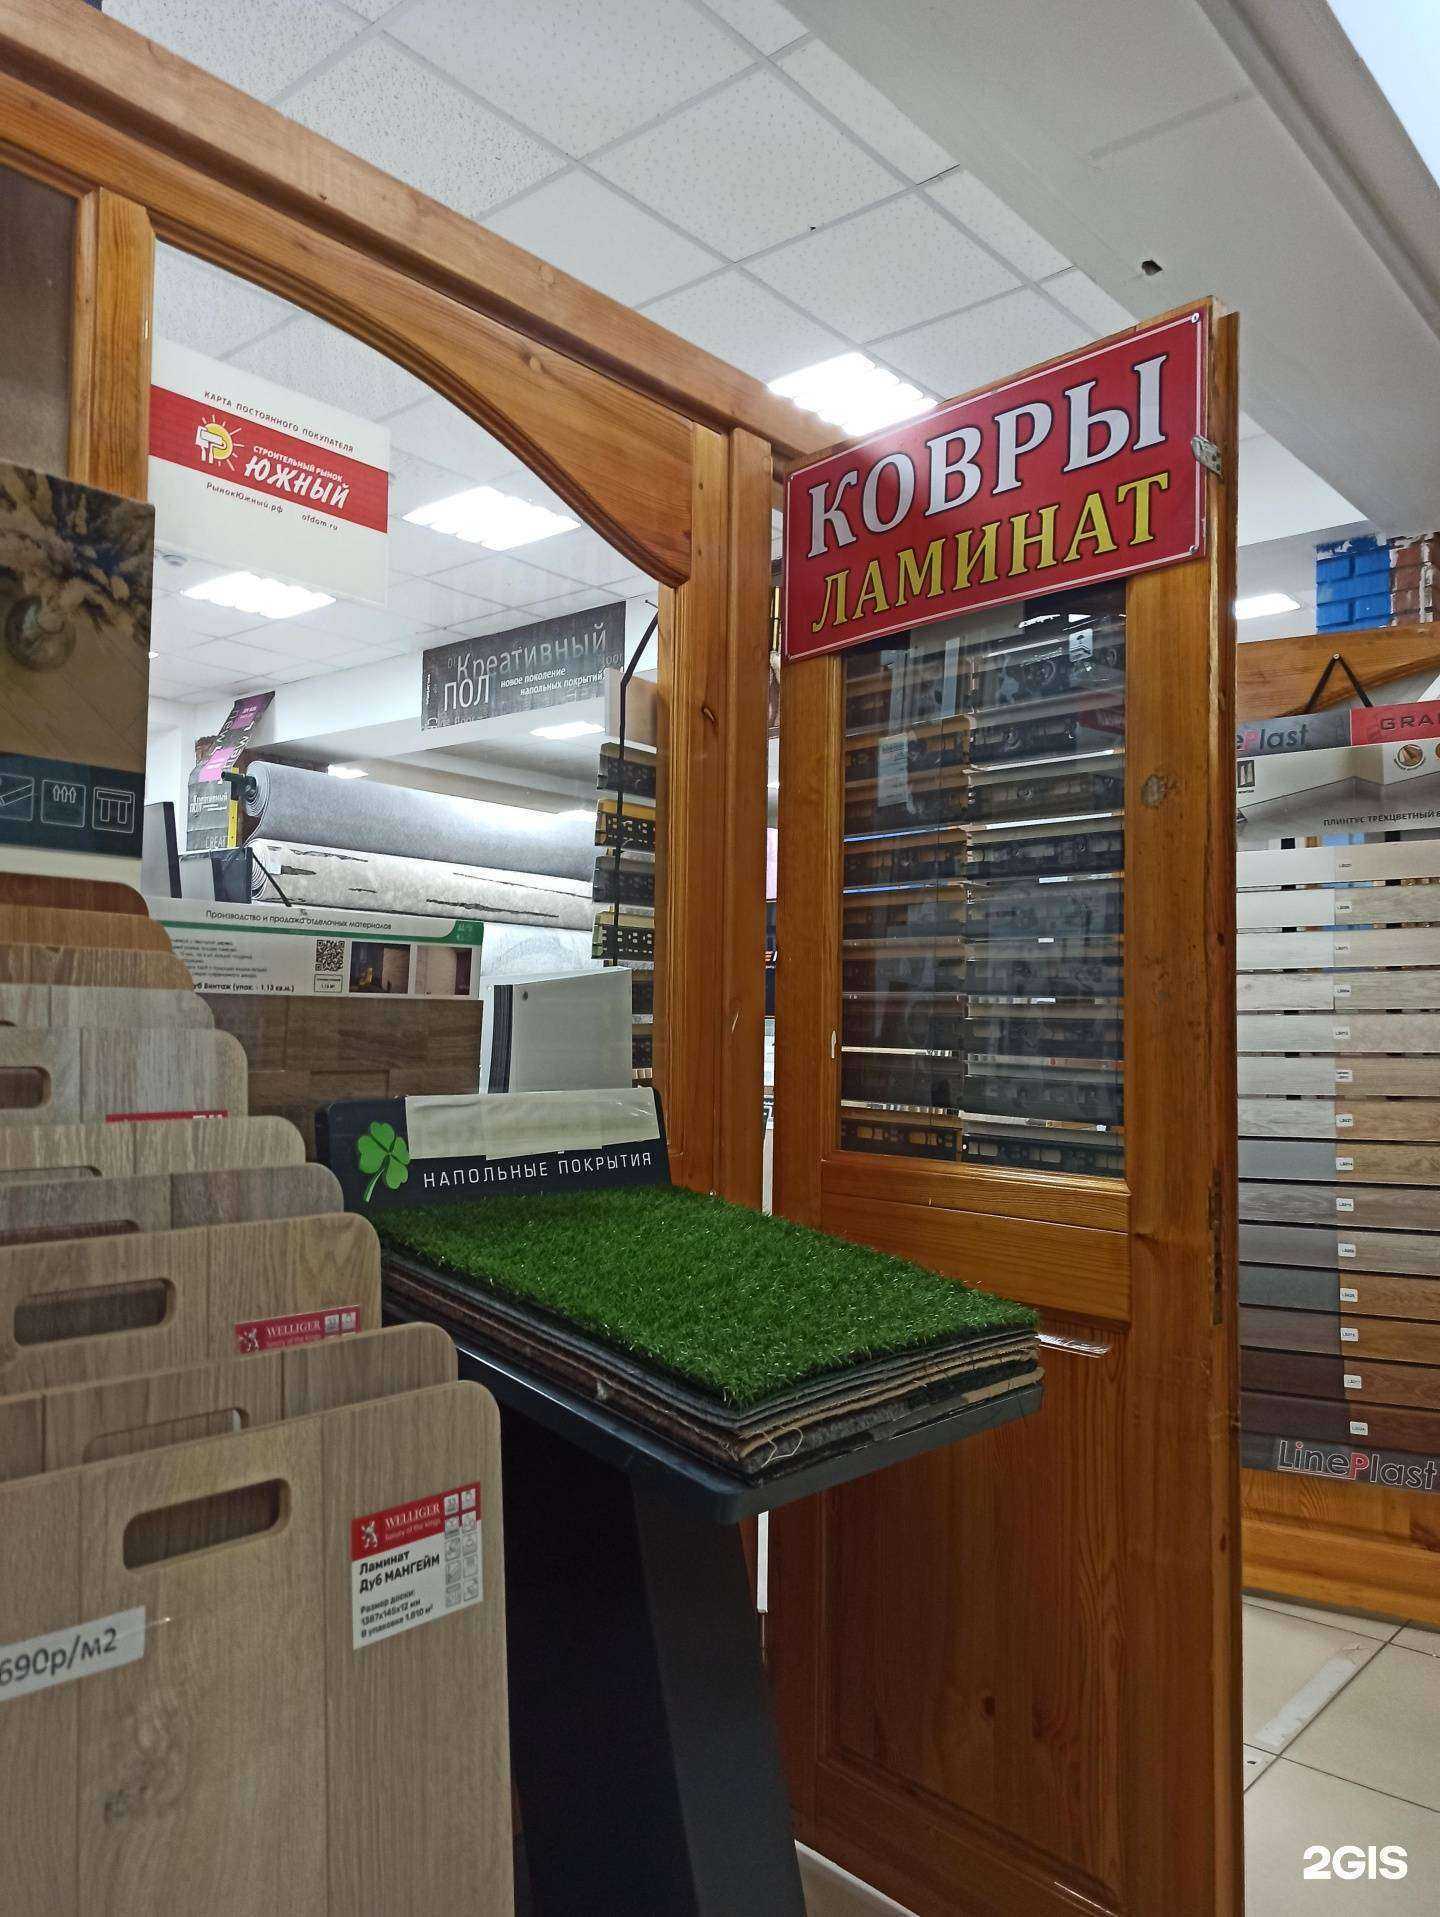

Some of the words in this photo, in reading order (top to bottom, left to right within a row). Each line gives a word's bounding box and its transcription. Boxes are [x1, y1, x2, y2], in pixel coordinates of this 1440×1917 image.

[204, 391, 232, 408] КАРТА
[236, 402, 299, 432] ПОСТОЯННОГО
[302, 428, 354, 453] ПОКУПАТЕЛЯ
[253, 445, 315, 473] СТРОИТЕЛЬНЫЙ
[315, 467, 343, 482] РЫНОК
[807, 354, 1168, 559] КОВРЫ
[244, 455, 350, 509] ЮЖНЫЙ
[811, 472, 1169, 634] ЛАМИНАТ
[456, 622, 606, 682] Креативный
[500, 674, 523, 689] новое
[524, 666, 566, 685] поколение
[520, 680, 563, 696] напольных
[1381, 712, 1440, 730] GRA
[1323, 816, 1367, 827] ПЛИНТУС
[205, 909, 261, 922] Производство
[269, 915, 306, 925] продажа
[306, 917, 348, 928] отделочных
[349, 920, 392, 930] материалов
[423, 1160, 548, 1188] НАПОЛЬНЫЕ
[558, 1152, 652, 1175] ПОКРЫТИЯ
[265, 1320, 321, 1337] WELLIGER
[1277, 1439, 1437, 1490] LinePlast
[385, 1502, 441, 1529] WELLIGER
[359, 1572, 383, 1595] Дуб
[384, 1553, 440, 1583] МАНГЕЙМ
[360, 1550, 410, 1575] Ламинат
